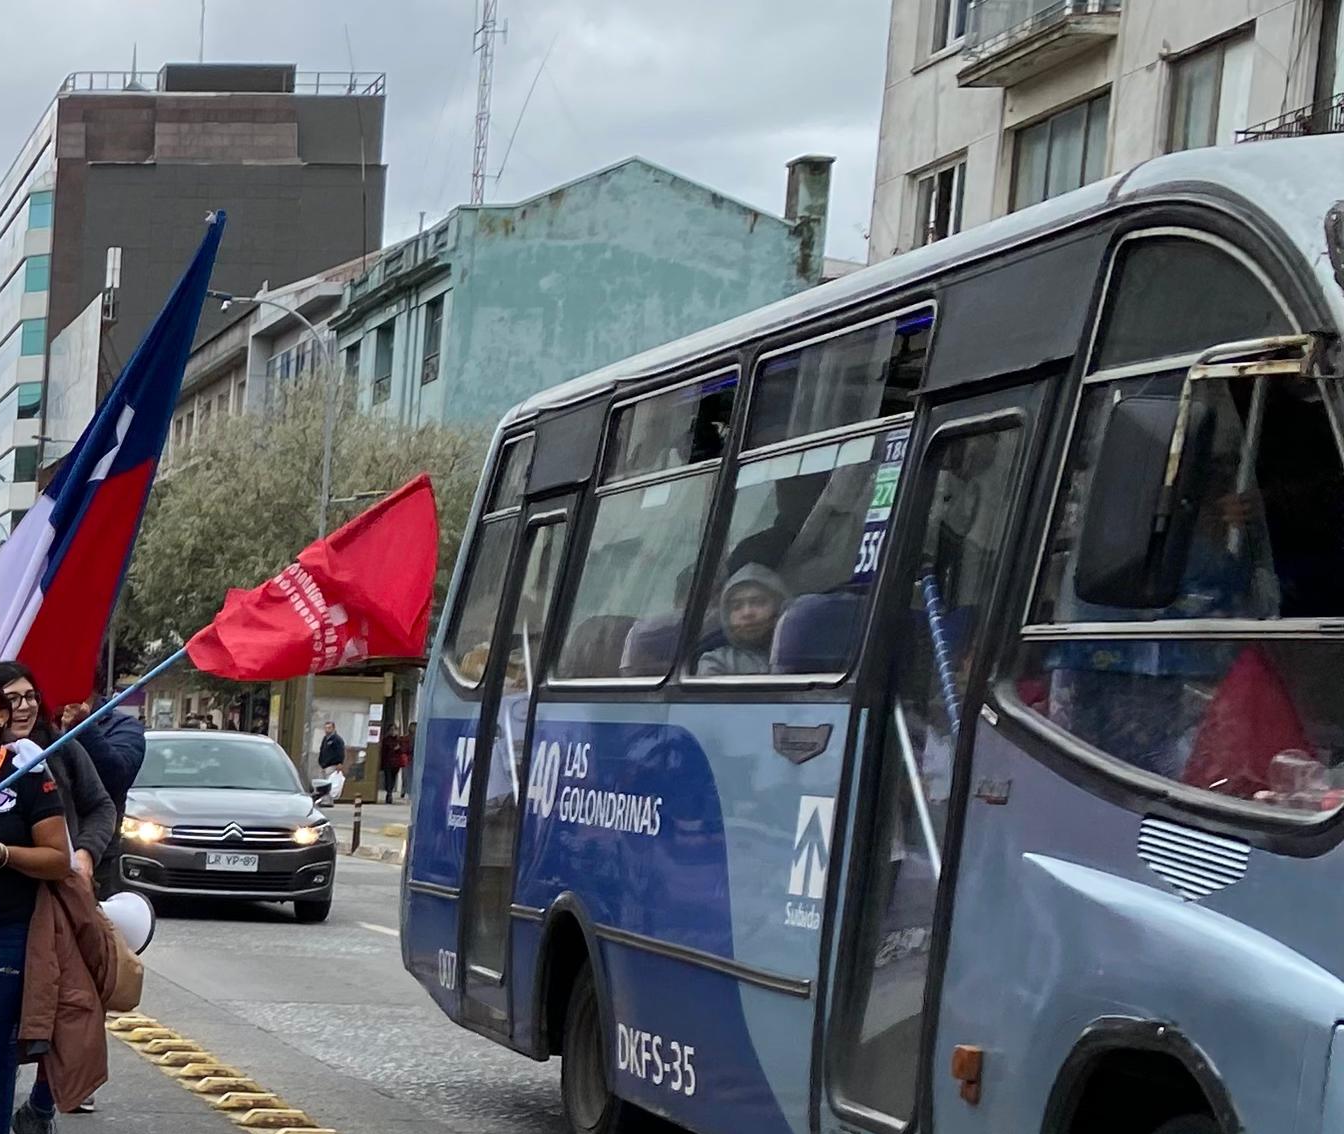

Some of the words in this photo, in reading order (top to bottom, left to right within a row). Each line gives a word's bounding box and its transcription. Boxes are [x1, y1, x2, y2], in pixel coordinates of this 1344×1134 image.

[527, 740, 560, 818] 40
[564, 741, 591, 779] LAS
[559, 786, 663, 836] GOLONDRINAS
[784, 901, 820, 930] Subida
[618, 1023, 696, 1097] DKFS-35
